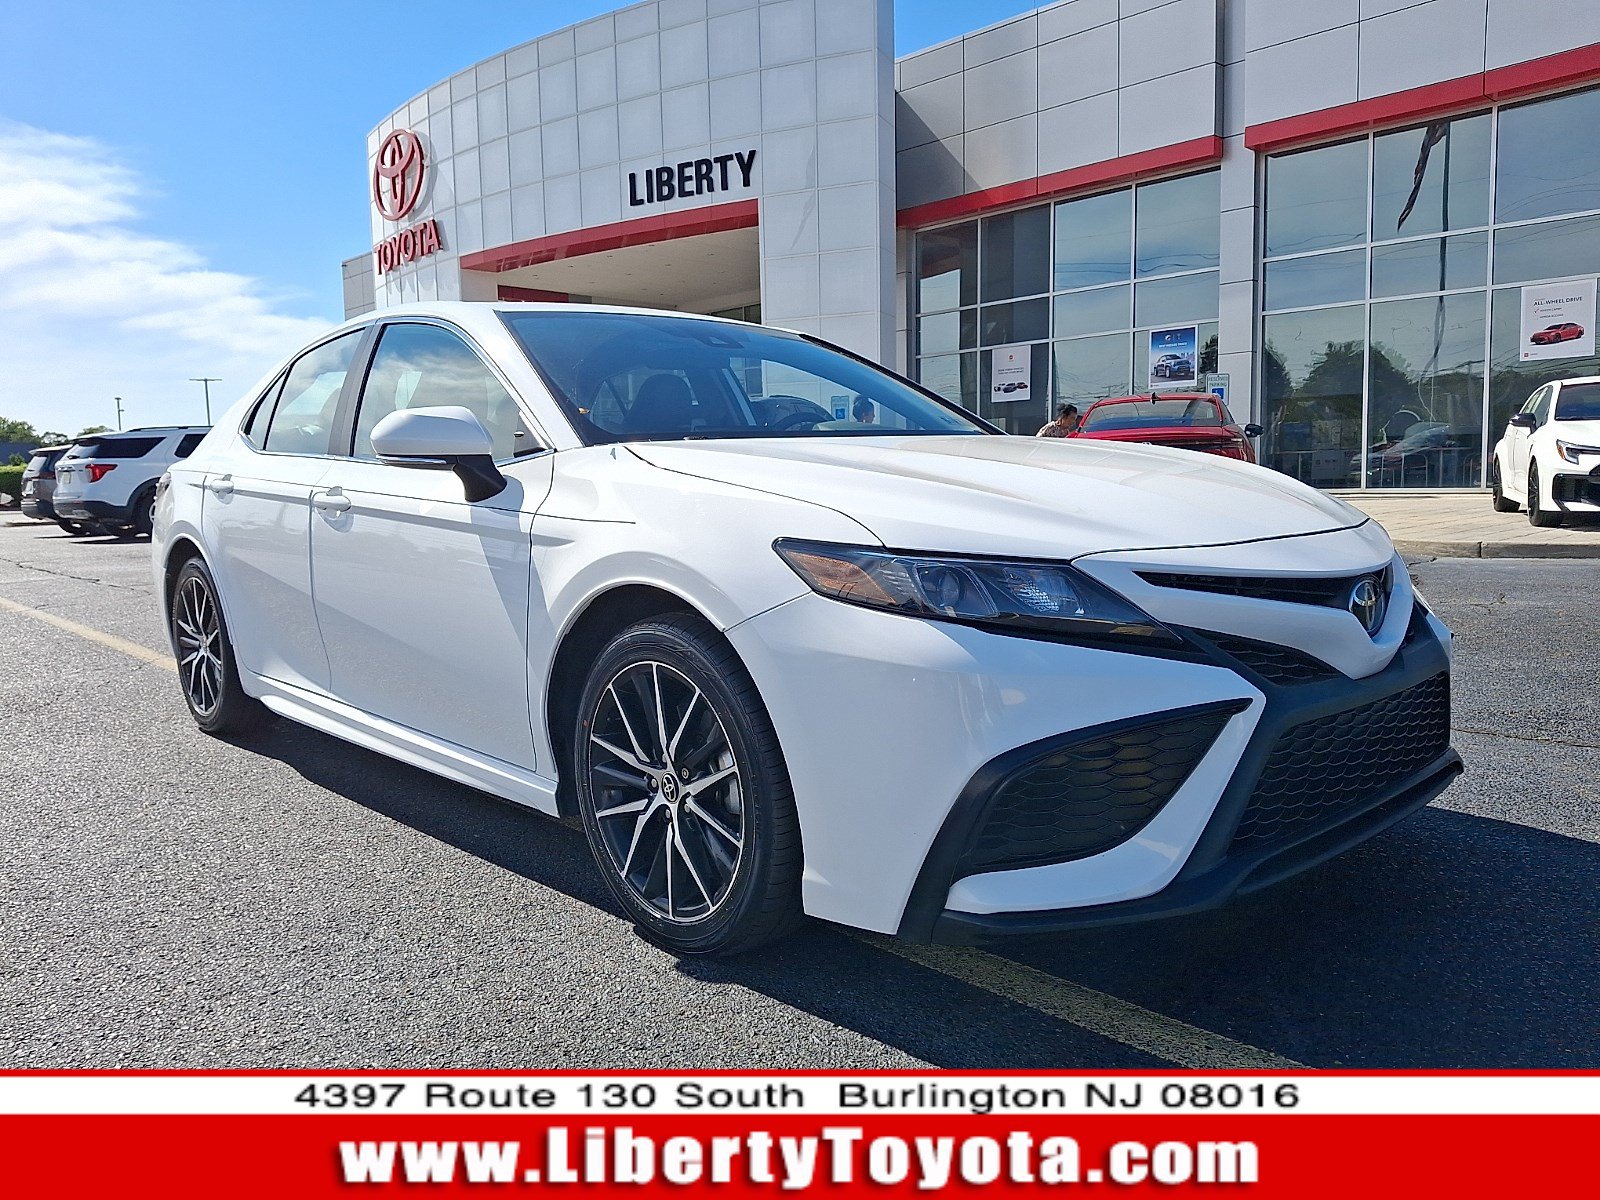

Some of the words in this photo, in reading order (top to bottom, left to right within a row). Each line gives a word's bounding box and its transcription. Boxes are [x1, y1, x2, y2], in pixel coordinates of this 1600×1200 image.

[628, 149, 758, 207] LIBERTY
[373, 219, 443, 275] TOYOTA
[1533, 298, 1565, 306] ALL-WHEEL
